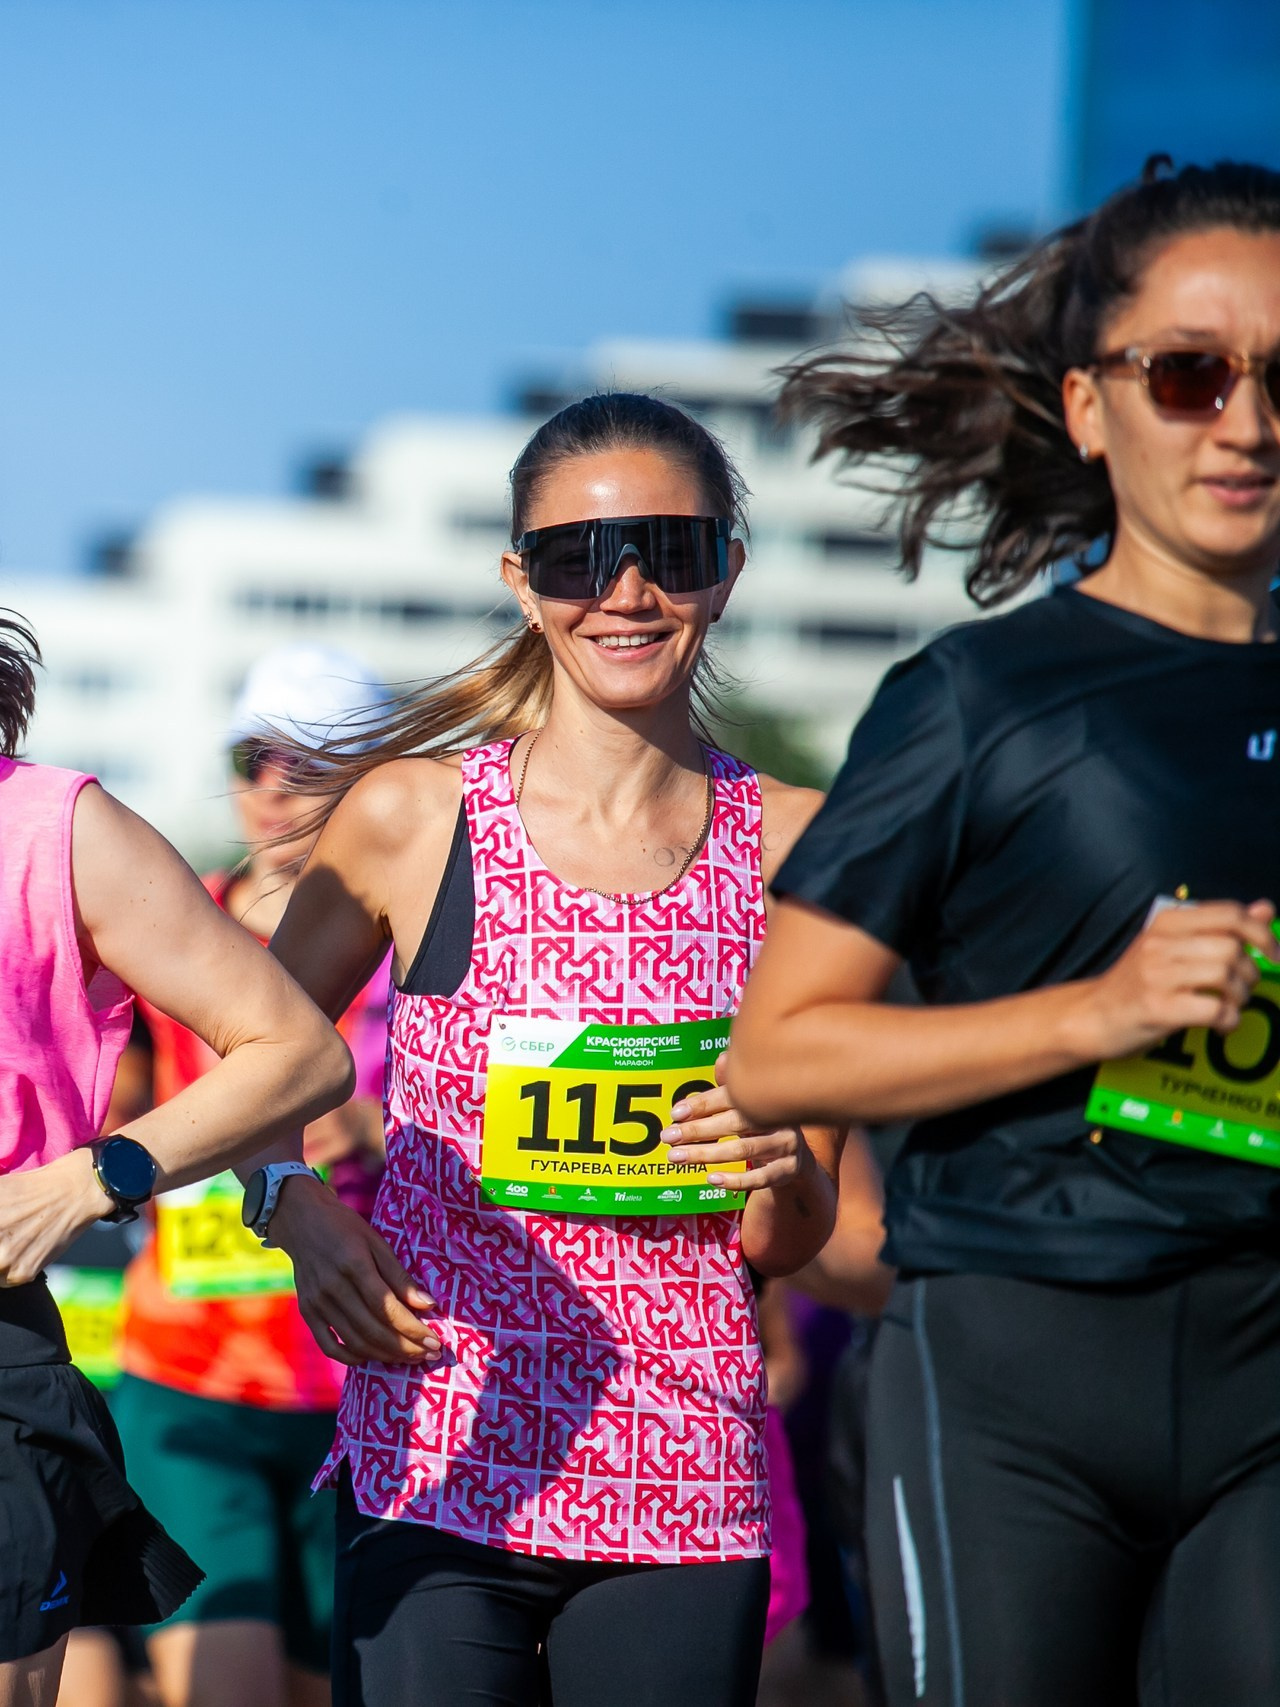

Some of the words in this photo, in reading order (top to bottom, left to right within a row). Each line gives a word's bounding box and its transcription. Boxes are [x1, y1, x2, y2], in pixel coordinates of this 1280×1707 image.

[520, 1041, 555, 1052] СБЕР
[586, 1035, 680, 1047] КРАСНОЯРСКИЕ
[700, 1040, 713, 1051] 10
[612, 1047, 657, 1058] МОСТЫ
[614, 1059, 654, 1067] МАРАФОН
[531, 1159, 613, 1175] ГУТАРЕВА
[617, 1162, 708, 1176] ЕКАТЕРИНА
[698, 1188, 727, 1200] 2026
